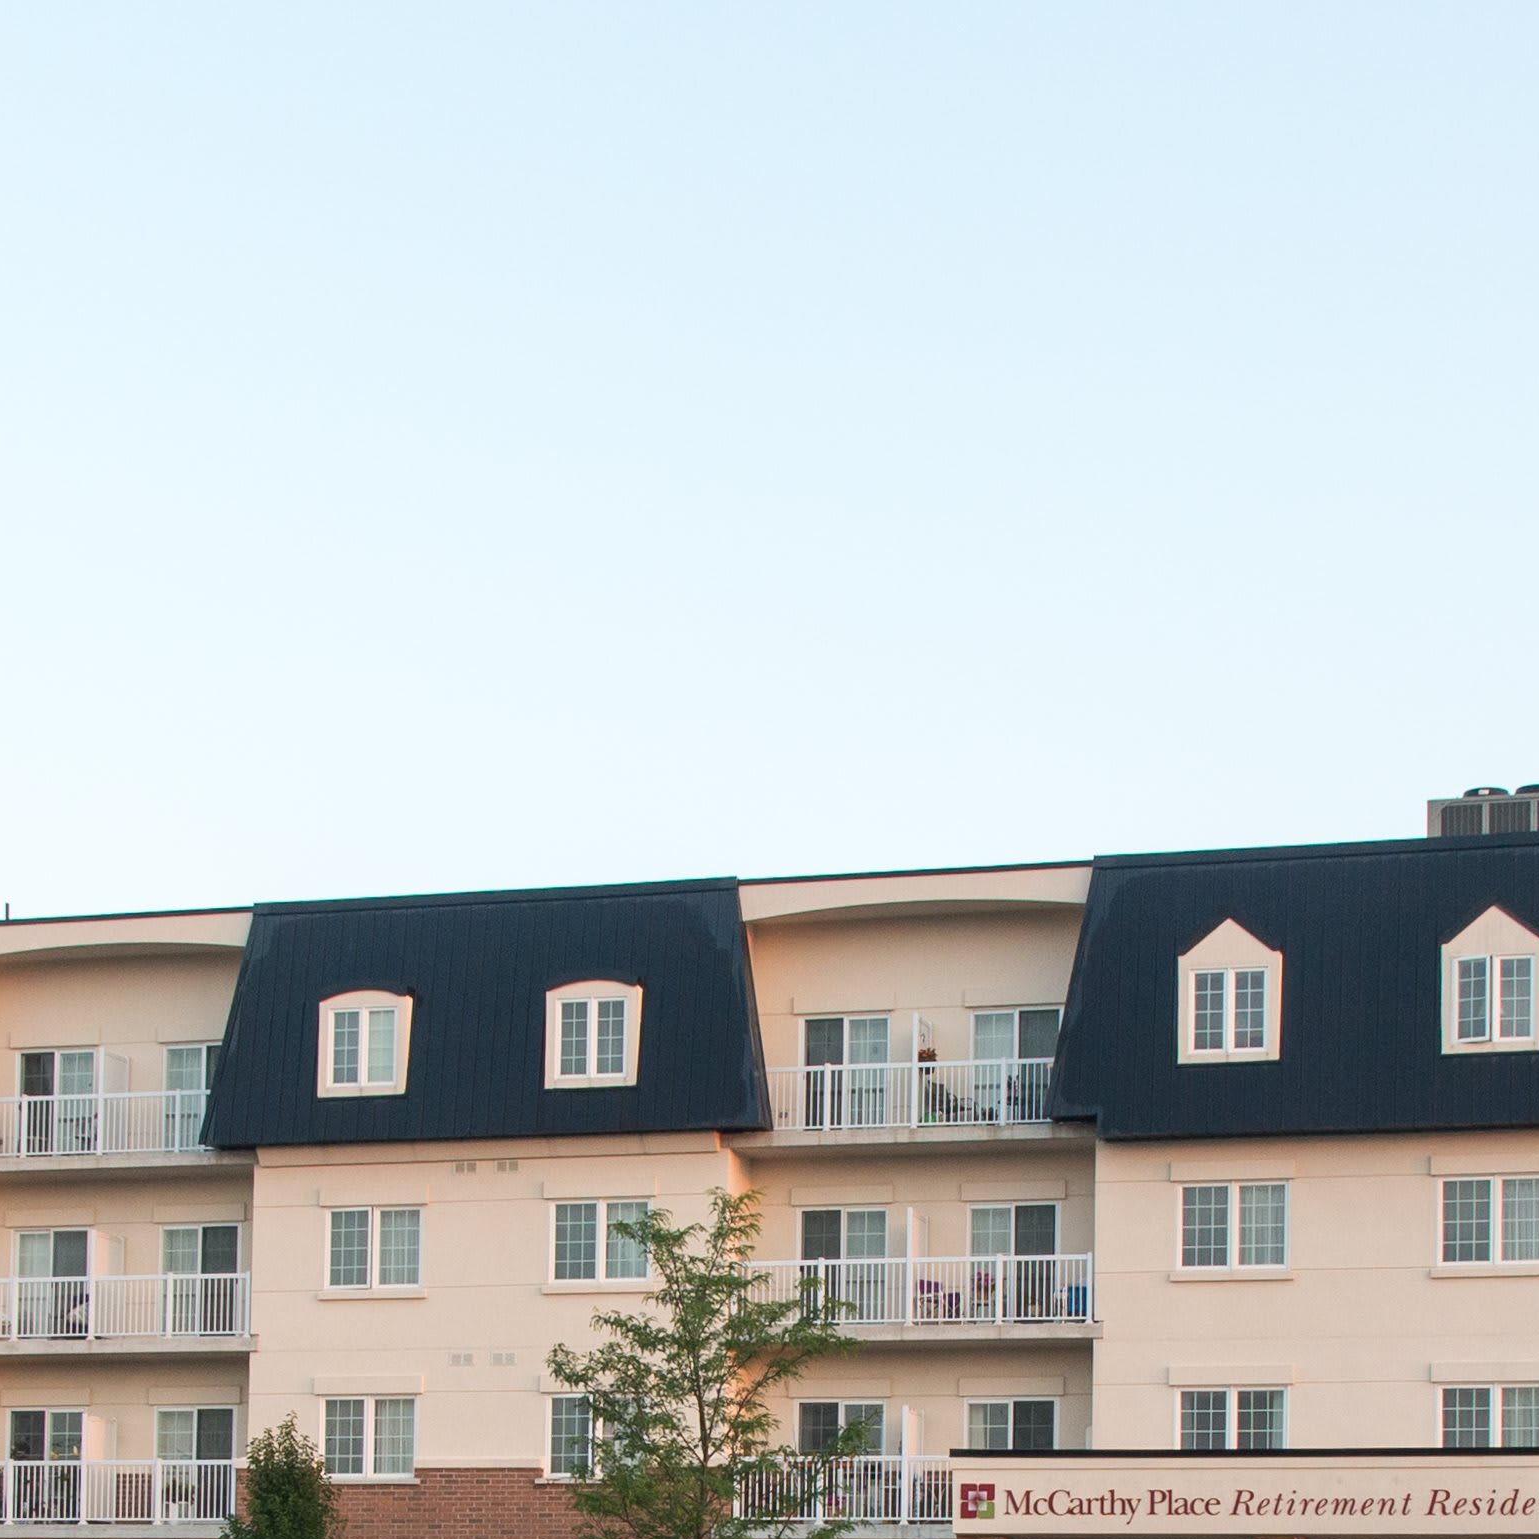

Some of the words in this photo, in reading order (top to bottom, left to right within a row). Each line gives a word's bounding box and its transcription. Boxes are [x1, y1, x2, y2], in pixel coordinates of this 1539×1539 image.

[1003, 1488, 1142, 1525] McCarthy
[1146, 1488, 1222, 1516] Place
[1229, 1488, 1412, 1516] Retirement
